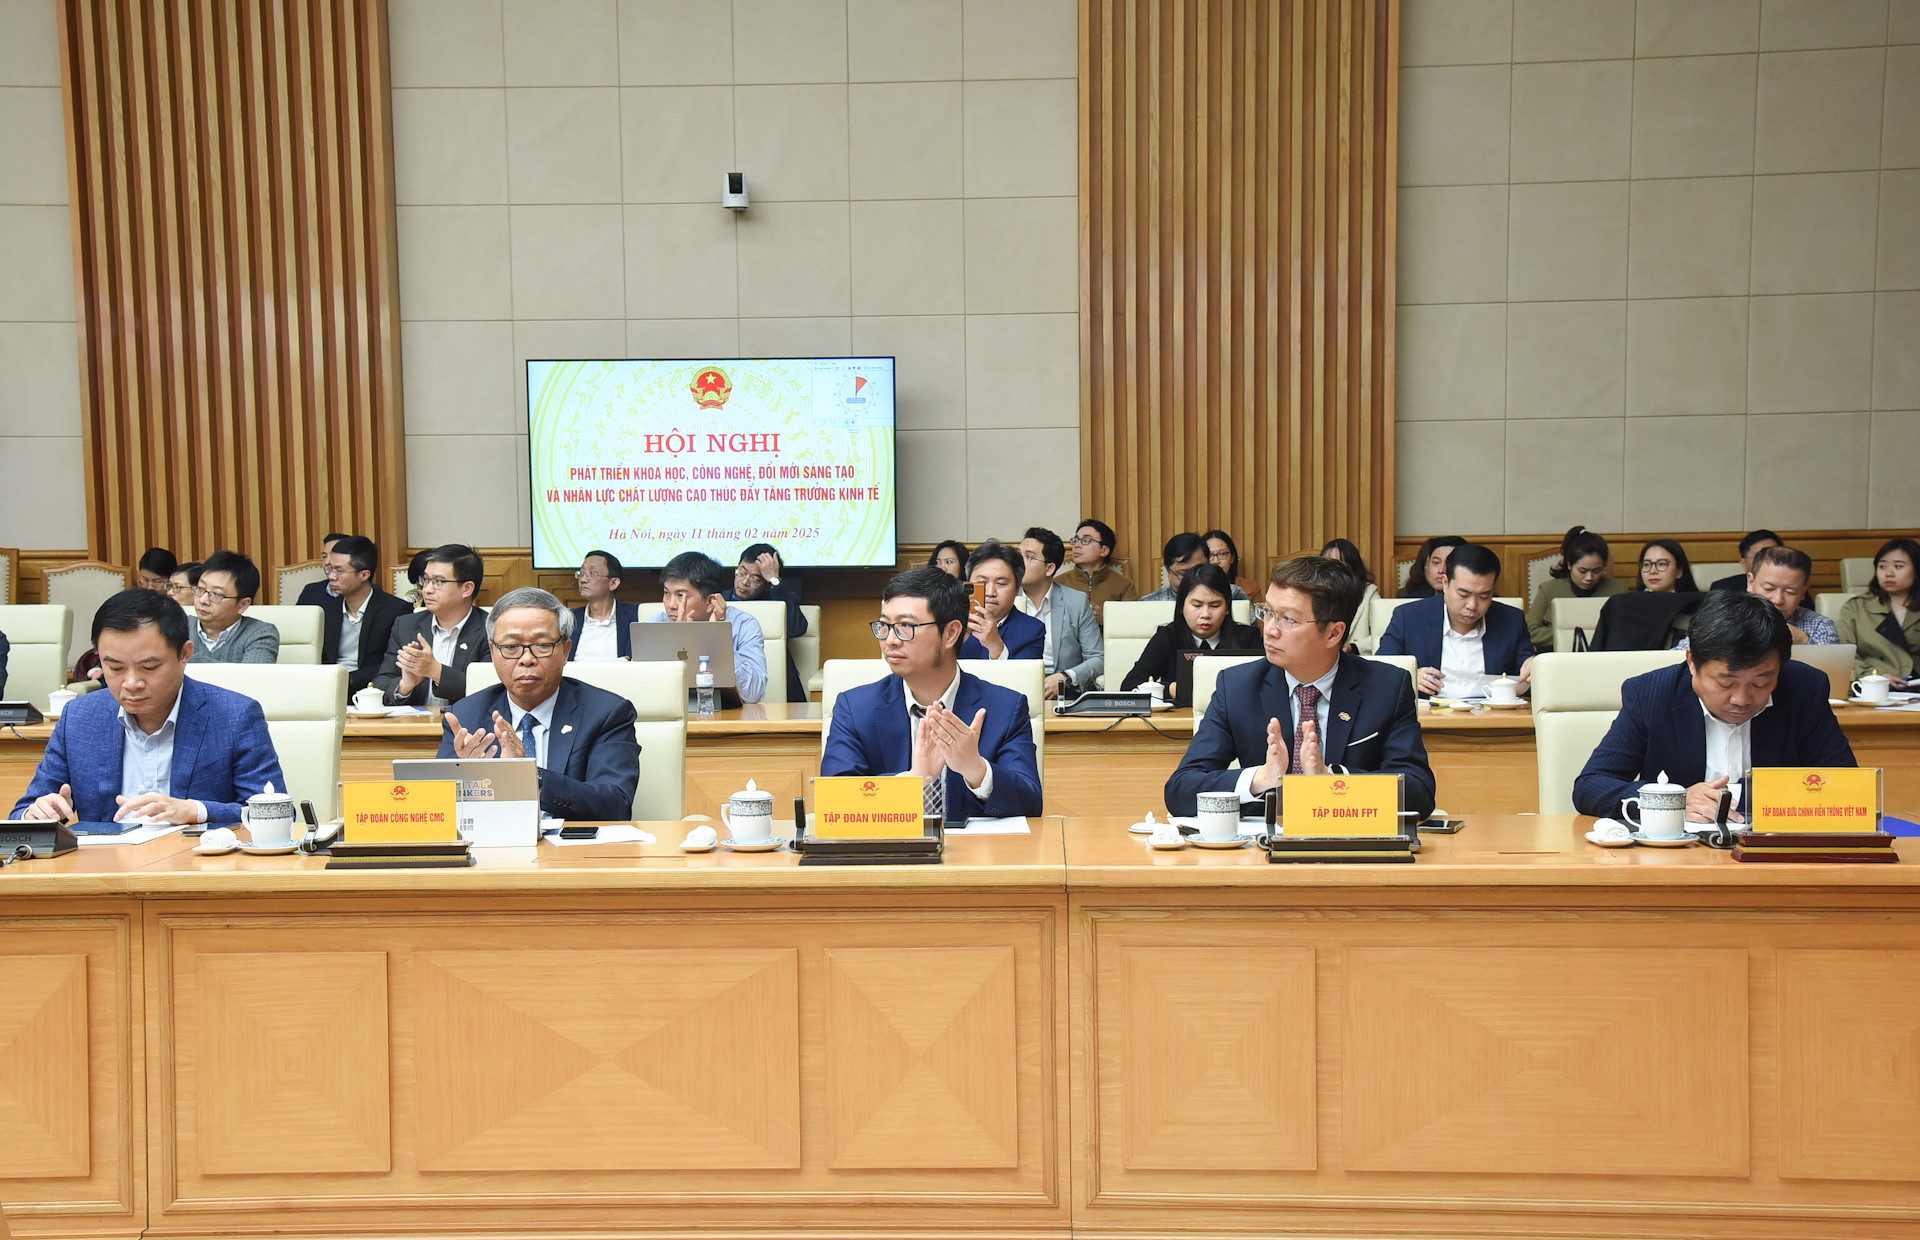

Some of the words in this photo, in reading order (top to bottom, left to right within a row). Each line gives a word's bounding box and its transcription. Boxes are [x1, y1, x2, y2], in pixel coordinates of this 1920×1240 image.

[643, 427, 696, 458] HỘI
[706, 433, 781, 458] NGHỊ
[570, 464, 597, 481] PHÁT
[600, 462, 630, 481] TRIỂN
[634, 467, 661, 481] KHOA
[665, 466, 689, 483] HỌC,
[692, 464, 721, 480] CÔNG
[724, 463, 756, 482] NGHỆ,
[758, 461, 776, 479] ĐỔI
[780, 462, 800, 479] MỚI
[803, 462, 832, 479] SÁNG
[835, 466, 855, 482] TẠO
[547, 487, 560, 503] VÀ
[564, 487, 592, 503] NHÂN
[596, 488, 615, 505] LỰC
[619, 485, 645, 502] CHẤT
[649, 488, 683, 505] LƯỢNG
[686, 488, 707, 502] CAO
[710, 486, 737, 502] THÚC
[740, 483, 760, 502] ĐẨY
[764, 486, 791, 501] TĂNG
[794, 483, 836, 501] TRƯỞNG
[839, 488, 864, 501] KINH
[867, 483, 880, 501] TẾ
[609, 529, 627, 540] Hà
[658, 529, 687, 541] ngày
[706, 528, 741, 541] tháng
[744, 528, 758, 539] 02
[762, 528, 789, 539] năm
[791, 527, 820, 539] 2025
[356, 812, 369, 825] TẬP
[370, 812, 389, 823] ĐOÀN
[390, 812, 409, 823] CÔNG
[410, 811, 428, 825] NGHỆ
[429, 812, 445, 823] CMC
[823, 811, 841, 826] TẬP
[843, 811, 869, 823] ĐOÀN
[871, 813, 918, 823] VINGROUP
[1312, 806, 1330, 820] TẬP
[1332, 806, 1359, 818] ĐOÀN
[1361, 808, 1379, 818] FPT
[1762, 805, 1771, 819] TẬP
[1772, 805, 1786, 817] ĐOÀN
[1844, 805, 1854, 819] VIỆT
[1855, 807, 1867, 817] NAM
